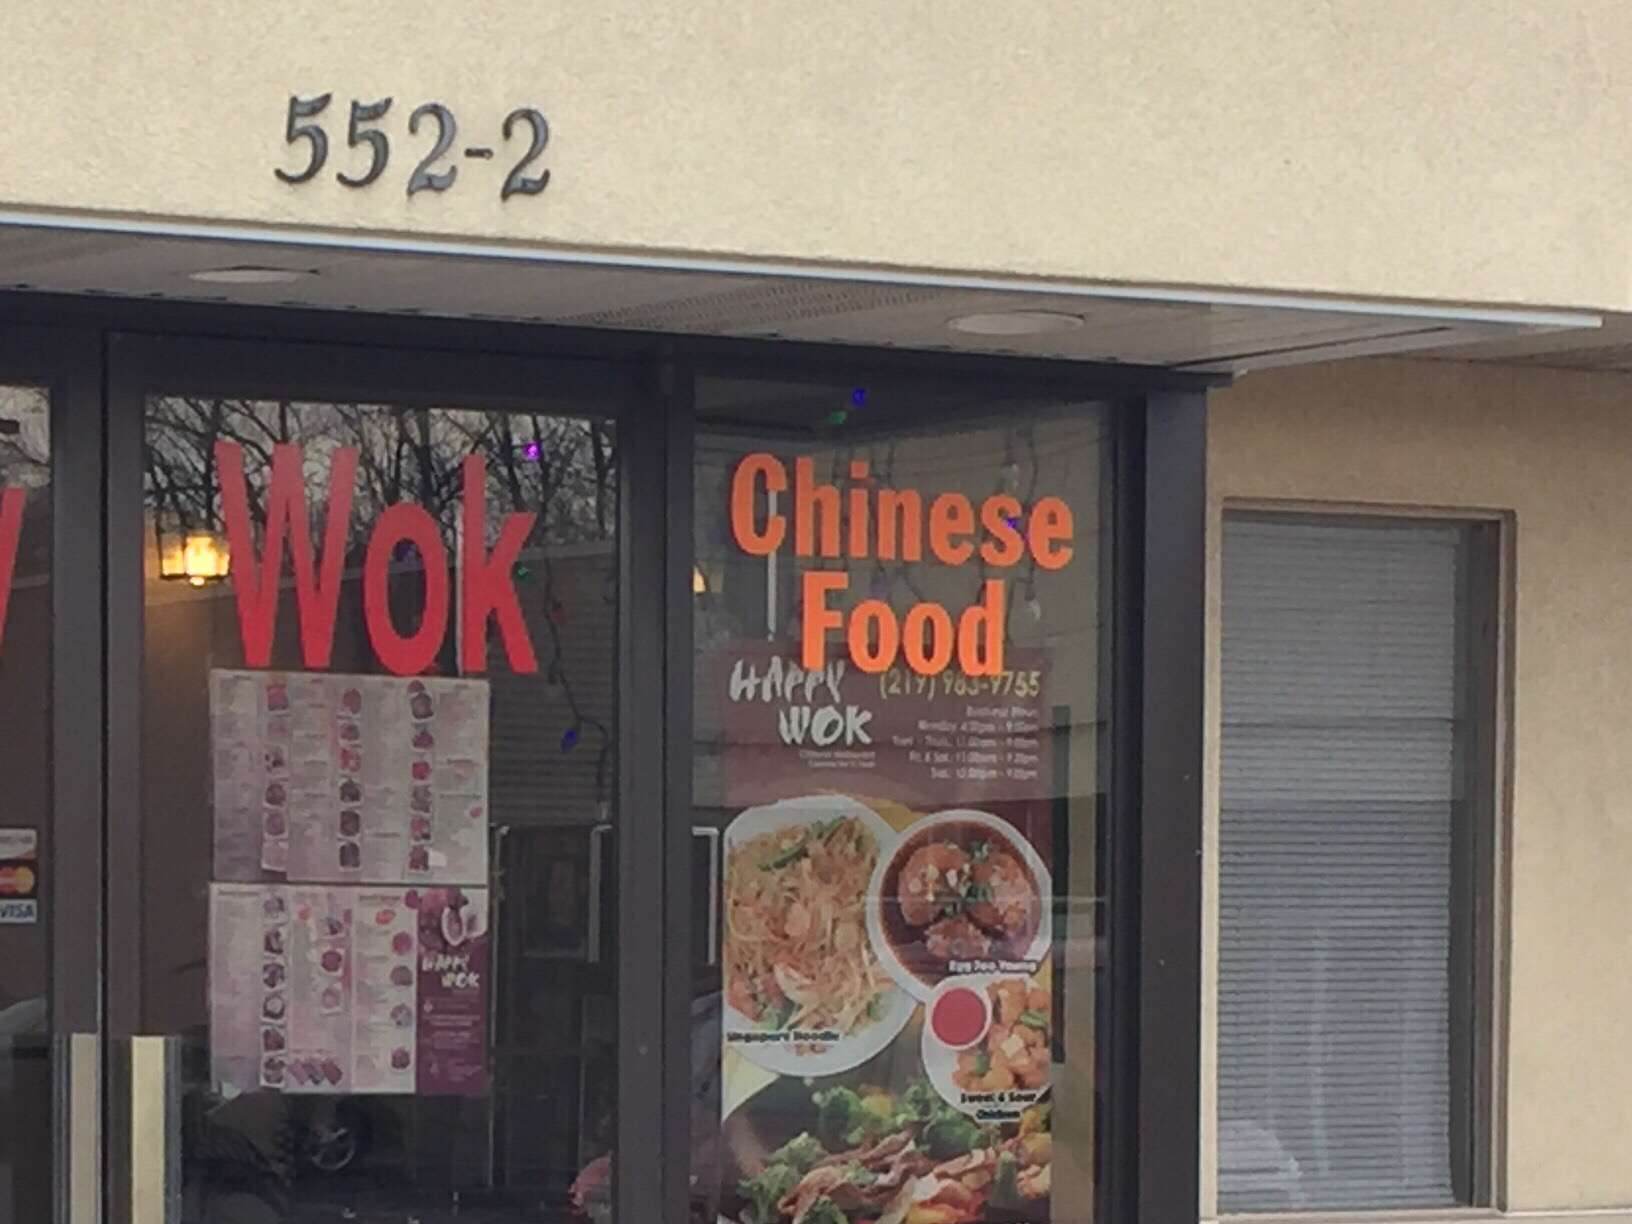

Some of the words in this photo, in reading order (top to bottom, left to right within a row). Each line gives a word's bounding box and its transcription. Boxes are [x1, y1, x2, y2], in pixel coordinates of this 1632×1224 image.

[274, 93, 551, 201] 552-2
[213, 440, 538, 675] Wok
[729, 453, 1074, 569] Chinese
[801, 571, 1005, 677] Food
[729, 655, 845, 702] HAPPY
[778, 705, 872, 747] WOK
[0, 903, 33, 918] VISA
